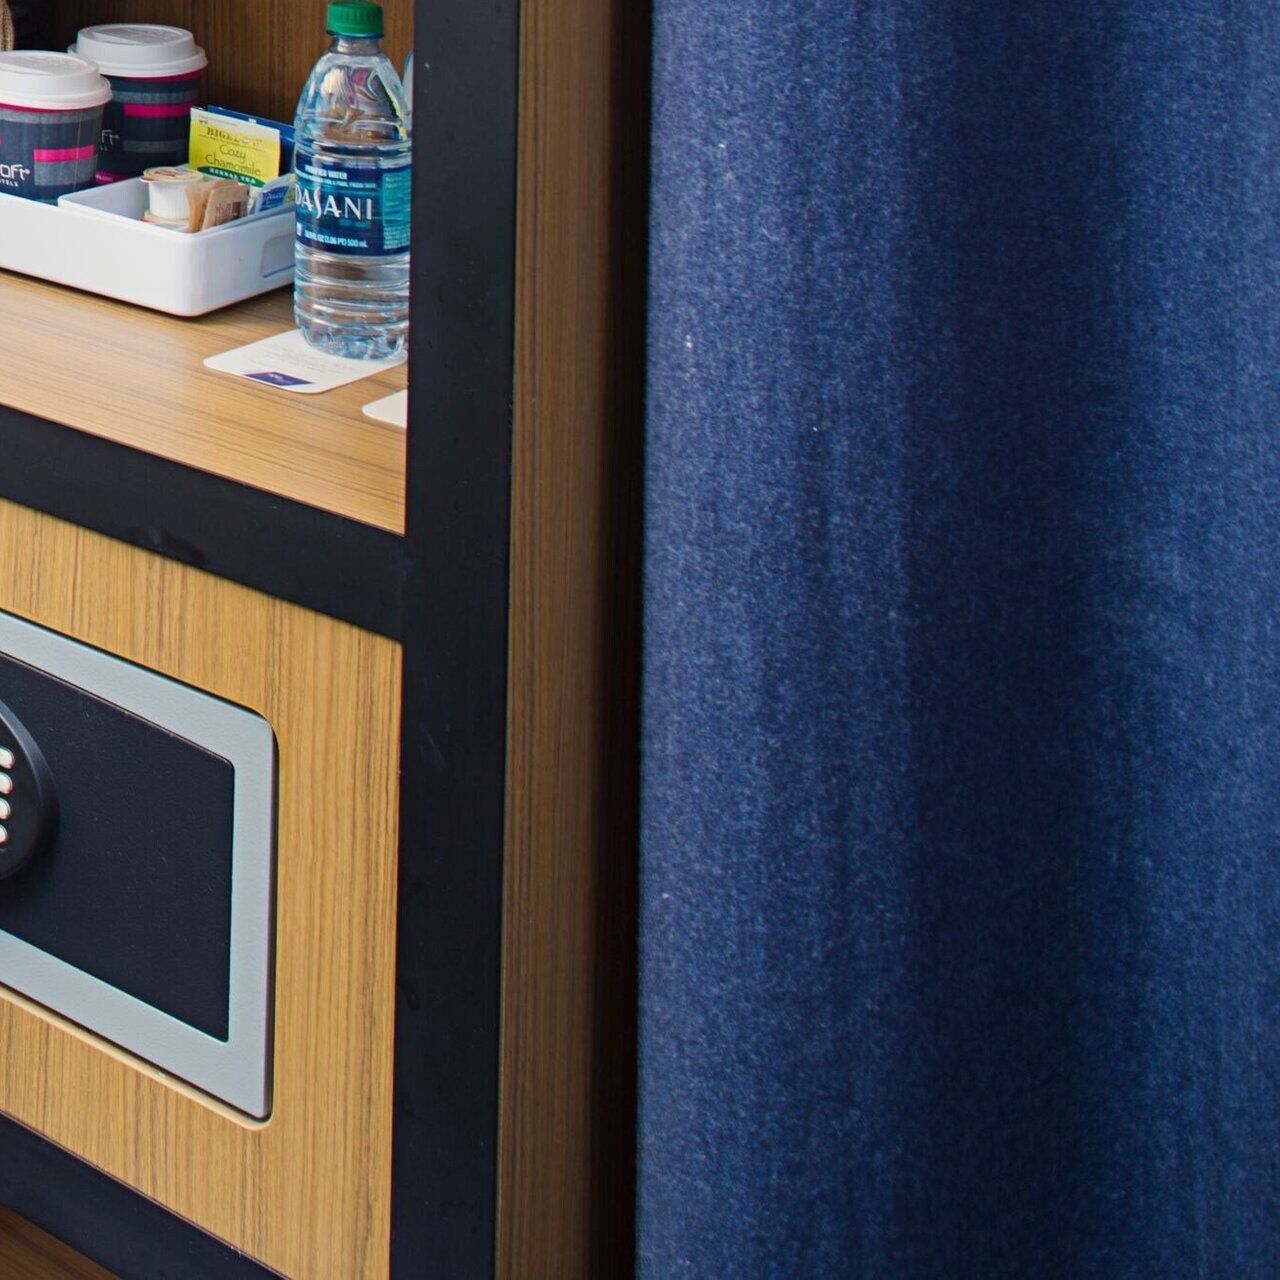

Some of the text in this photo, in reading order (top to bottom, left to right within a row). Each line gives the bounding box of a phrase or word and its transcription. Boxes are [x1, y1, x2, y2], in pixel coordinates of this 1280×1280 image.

[219, 144, 246, 163] Cozy
[205, 154, 262, 176] Chamomile
[328, 170, 348, 180] WATER
[295, 183, 372, 220] DASANI
